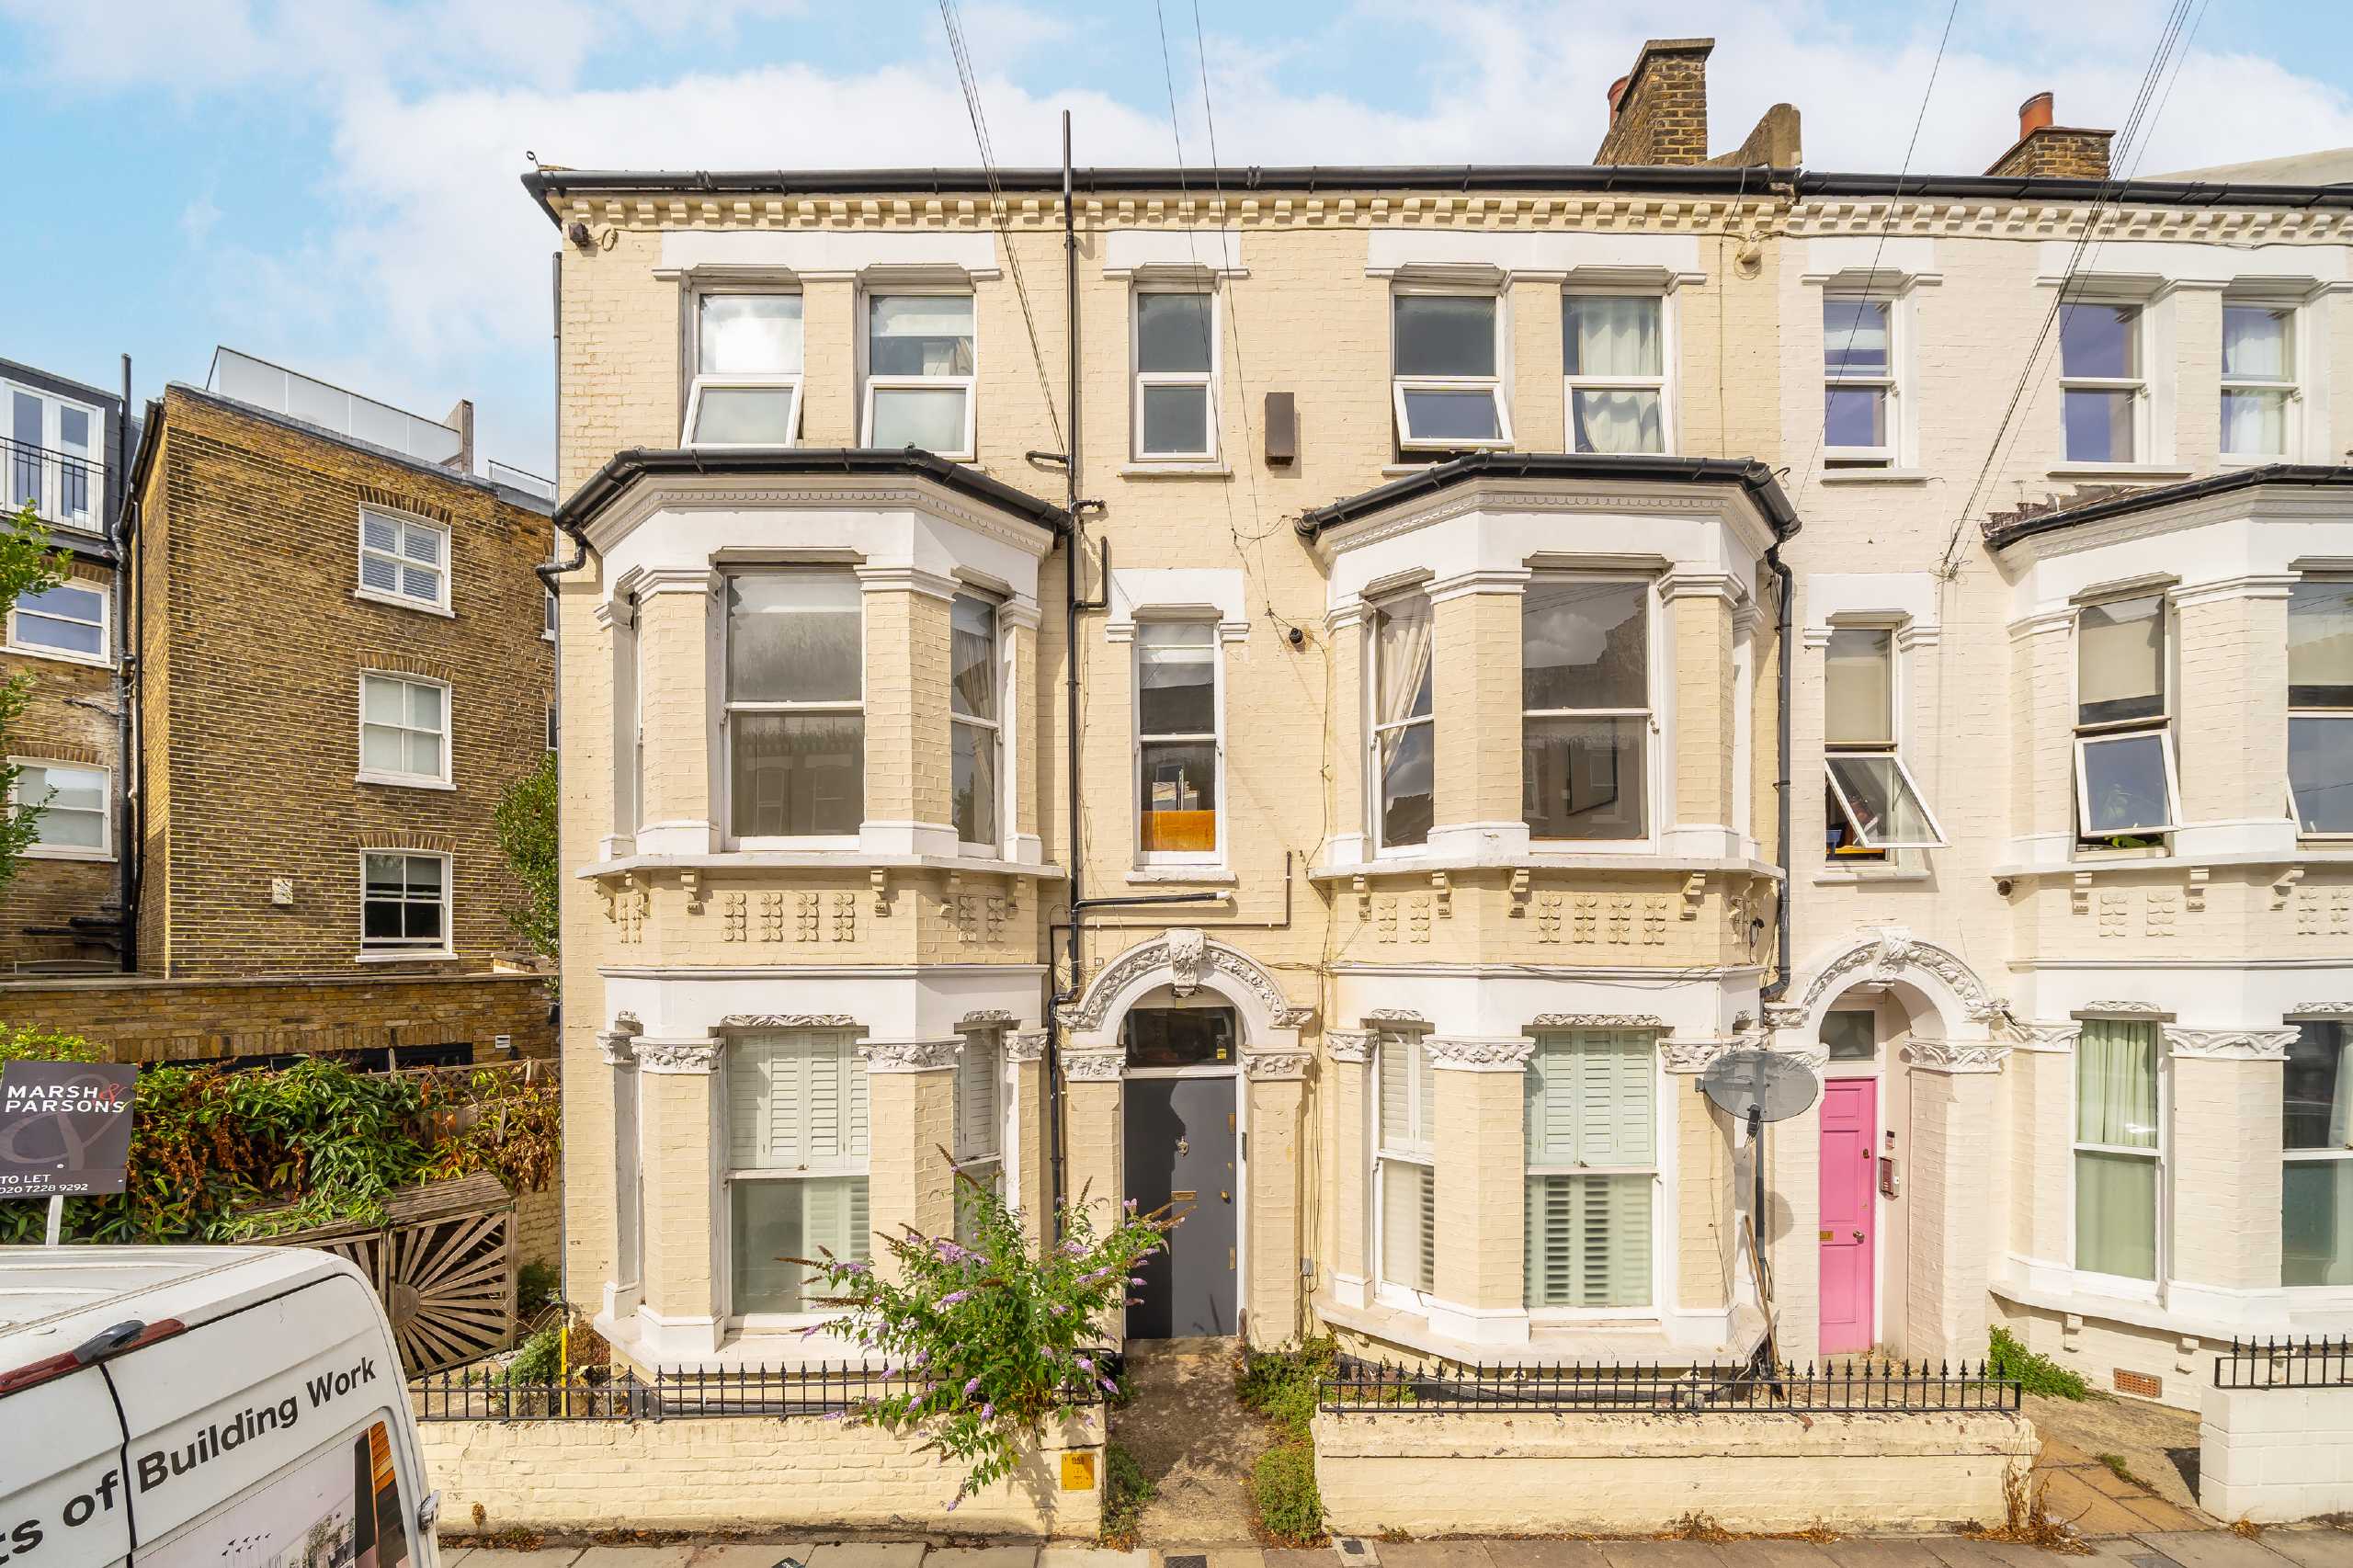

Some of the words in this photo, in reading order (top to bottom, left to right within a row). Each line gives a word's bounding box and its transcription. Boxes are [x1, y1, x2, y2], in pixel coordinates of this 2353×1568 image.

[6, 1085, 98, 1098] MARSH
[5, 1099, 126, 1113] PARSONS
[0, 1176, 19, 1185] TO
[24, 1174, 51, 1183] LET
[26, 1185, 56, 1193] 7228
[59, 1183, 88, 1191] 9292
[63, 1469, 119, 1528] of
[136, 1395, 299, 1494] Building
[305, 1356, 377, 1409] Work
